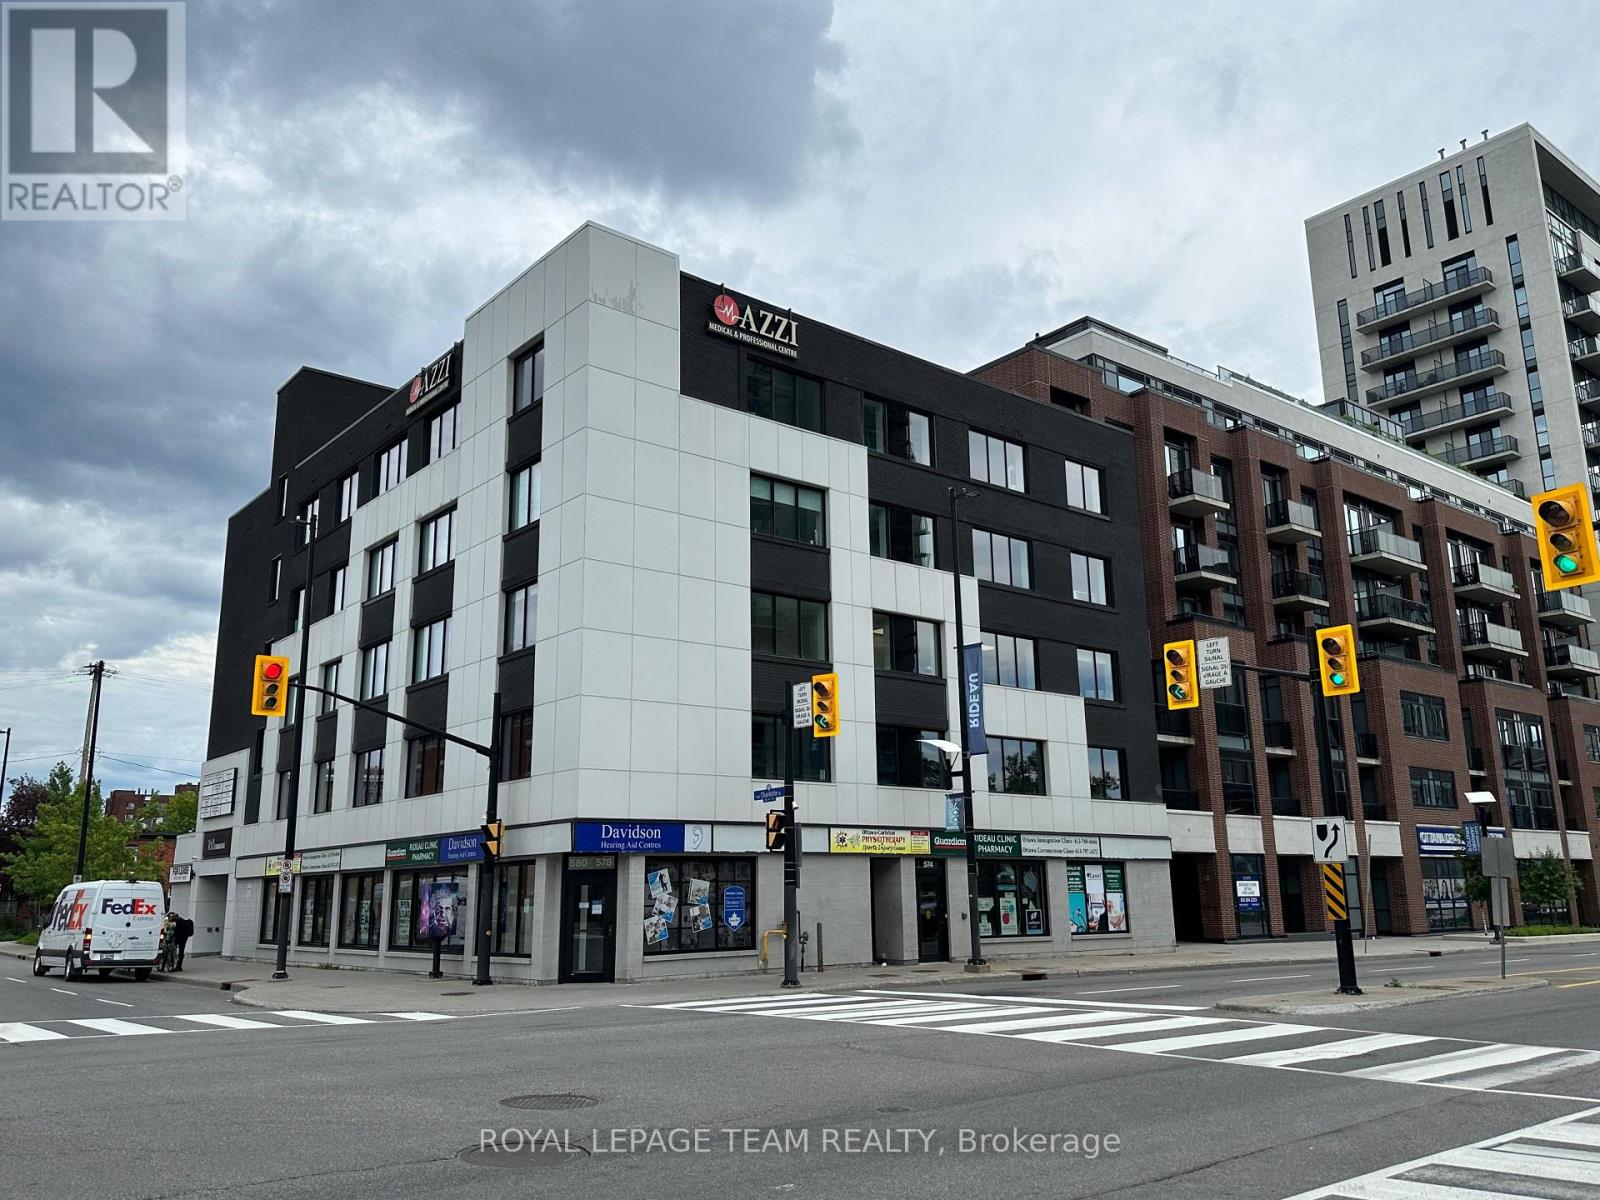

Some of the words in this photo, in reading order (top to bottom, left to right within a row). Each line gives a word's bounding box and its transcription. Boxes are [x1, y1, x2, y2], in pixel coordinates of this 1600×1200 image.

[740, 304, 799, 347] AZZI
[709, 322, 733, 336] MEDICAL
[733, 331, 740, 339] &
[739, 332, 779, 351] PROFESSIONAL
[778, 345, 798, 358] CENTRE
[1201, 665, 1219, 673] SIGNAL
[1205, 677, 1226, 685] GAUCHE
[601, 824, 661, 839] Davidson
[448, 836, 477, 850] Davidson
[862, 835, 906, 844] PHYSIOTHERAPY
[934, 837, 967, 846] Guardian
[974, 834, 996, 843] RIDEAU
[996, 835, 1017, 843] CLINIC
[600, 841, 625, 850] Hearing
[626, 841, 638, 849] Aid
[638, 841, 661, 849] Centres
[978, 845, 1013, 853] PHARMACY
[411, 852, 434, 861] PHARMACY
[102, 898, 156, 915] FedEx
